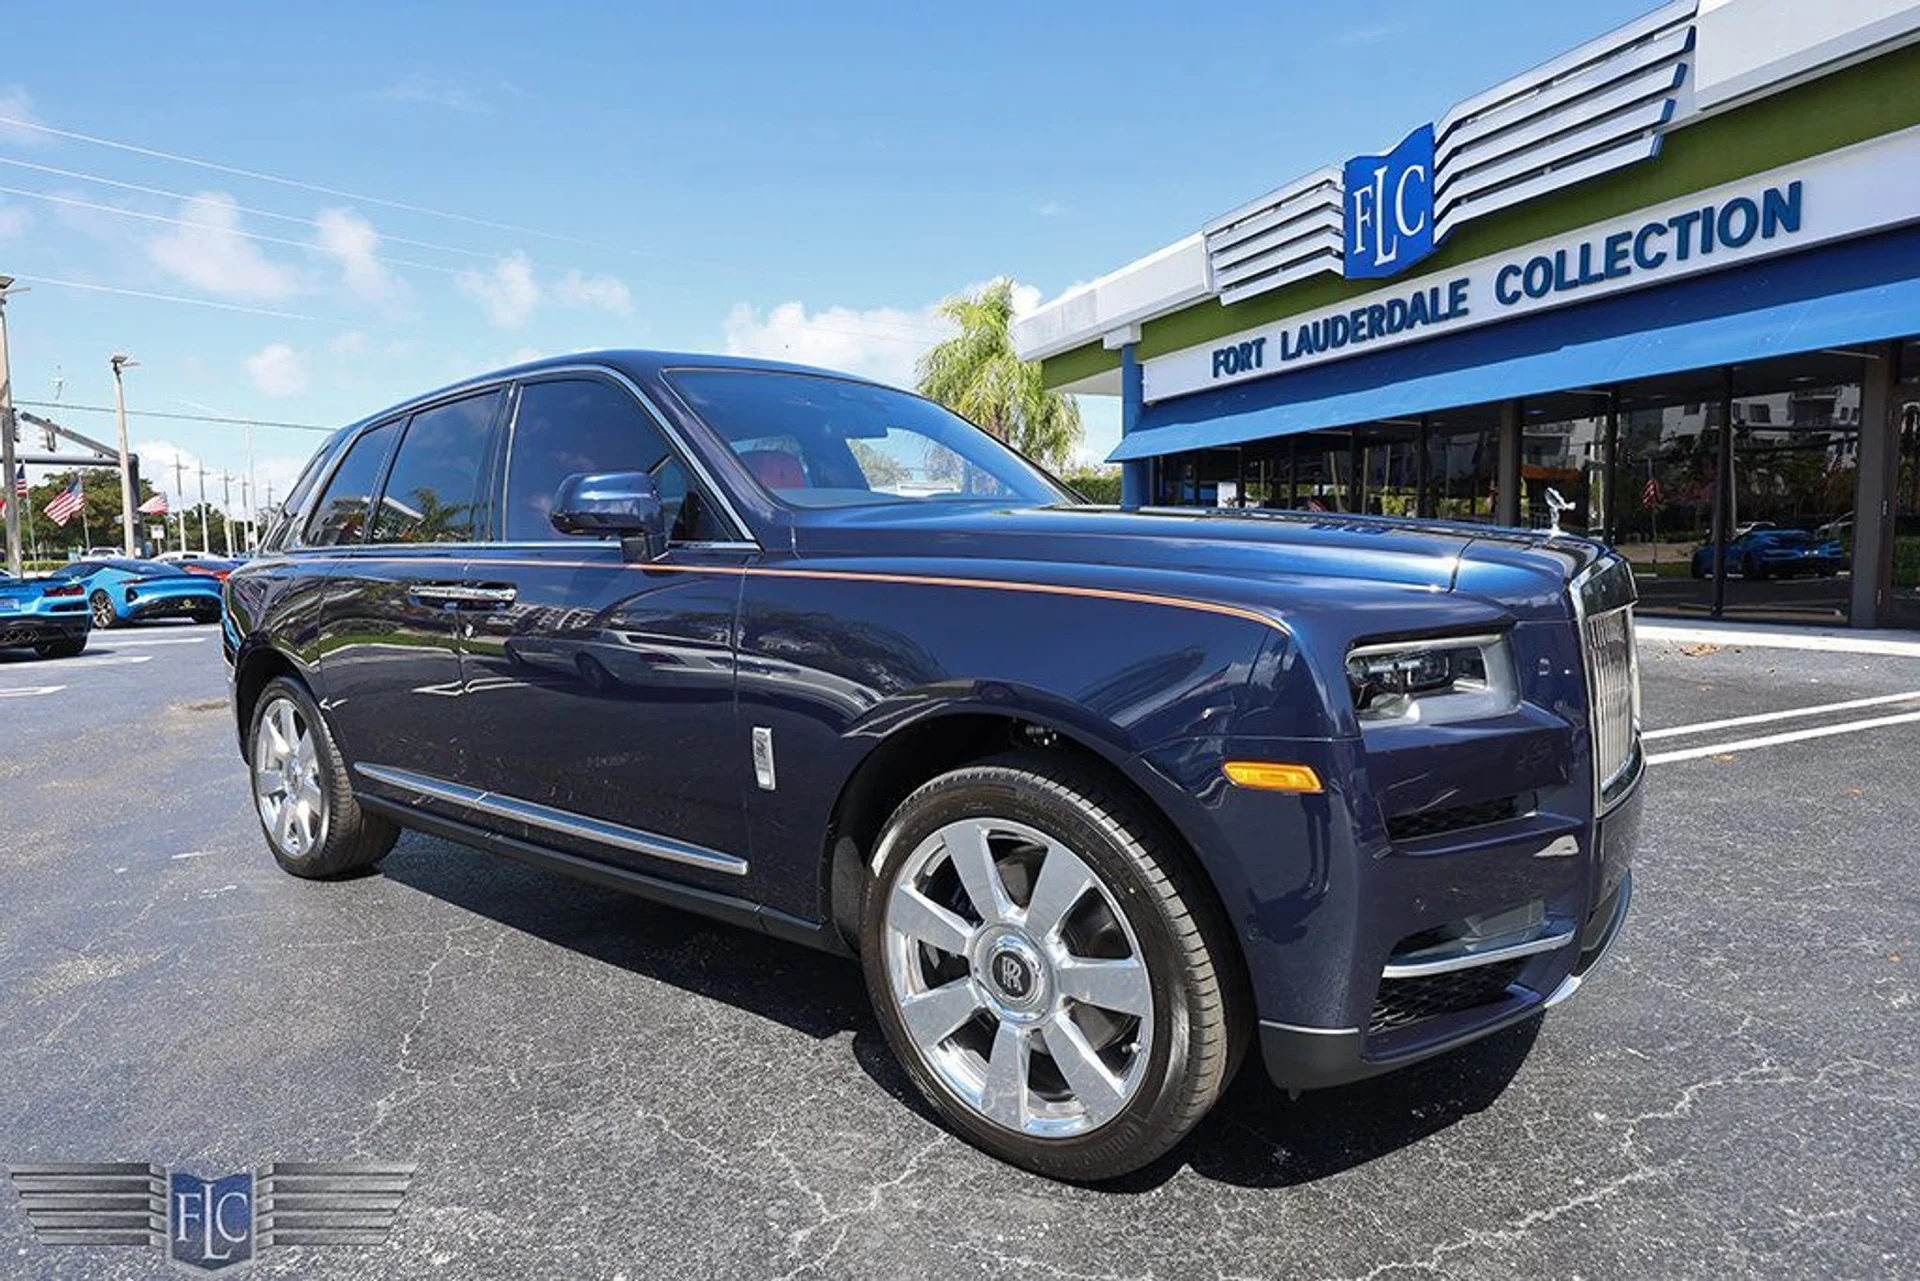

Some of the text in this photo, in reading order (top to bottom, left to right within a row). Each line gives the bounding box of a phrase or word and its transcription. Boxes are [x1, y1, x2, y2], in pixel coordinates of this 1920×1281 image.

[1212, 180, 1803, 379] FORT LAUDERDALE COLLECTION
[1353, 164, 1425, 267] FLC
